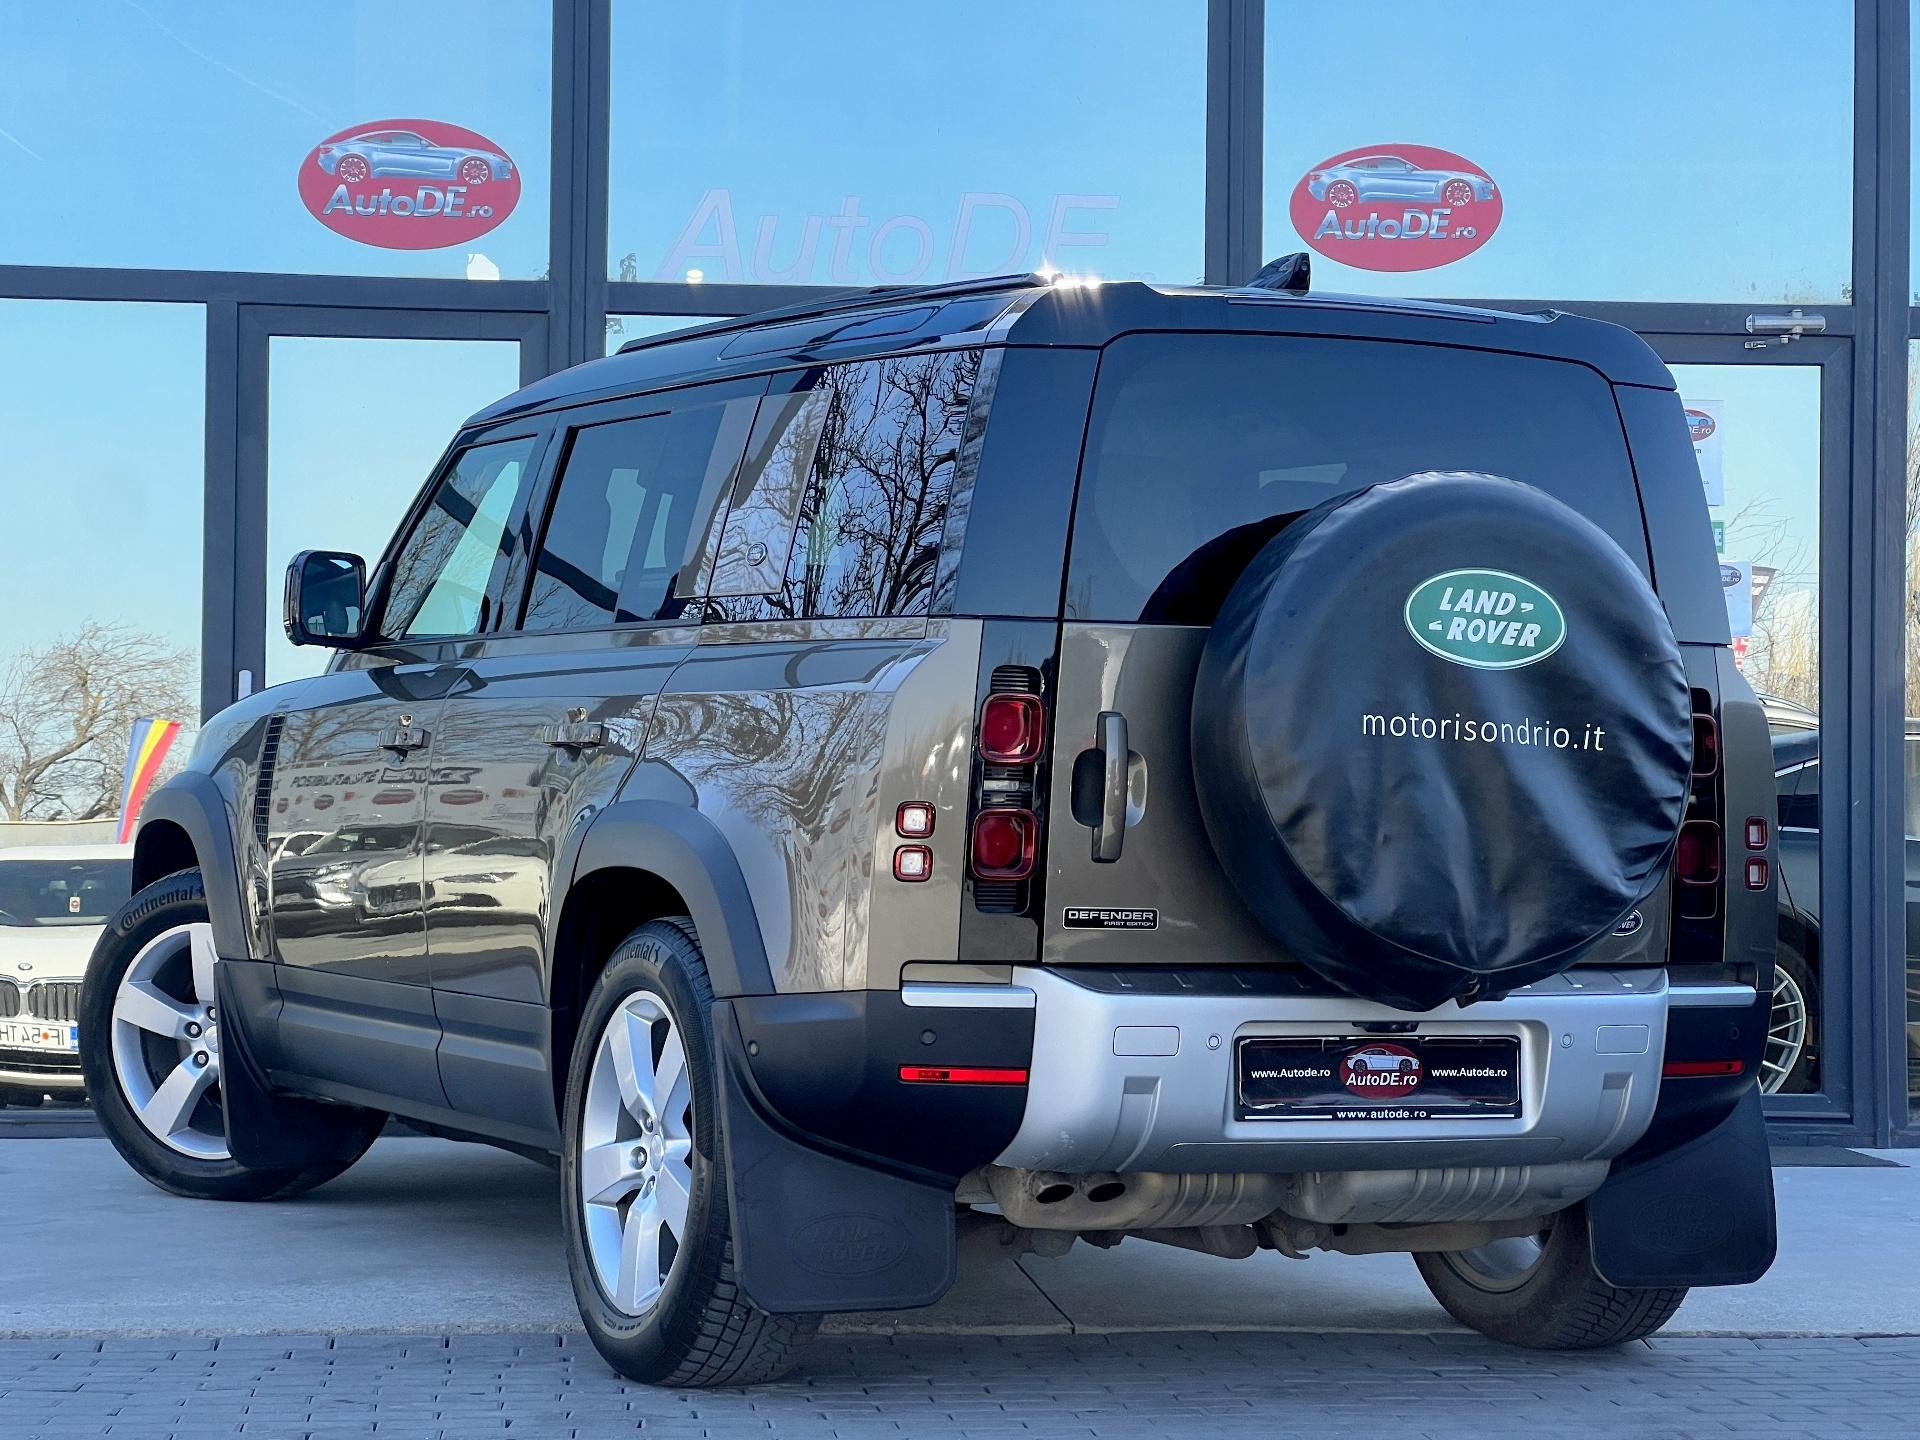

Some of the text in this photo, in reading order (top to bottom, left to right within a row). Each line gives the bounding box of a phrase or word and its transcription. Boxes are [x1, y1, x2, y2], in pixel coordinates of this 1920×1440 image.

[1439, 587, 1517, 616] LAND
[1446, 617, 1542, 647] ROVER
[1362, 712, 1606, 751] motorisondrio.it
[1068, 910, 1154, 920] DEFENDER
[1250, 1067, 1331, 1079] www.Autode.ro
[1431, 1067, 1508, 1078] www.Autode.ro
[1346, 1072, 1418, 1087] AutoDE.ro
[1336, 1108, 1428, 1120] www.autode.ro
